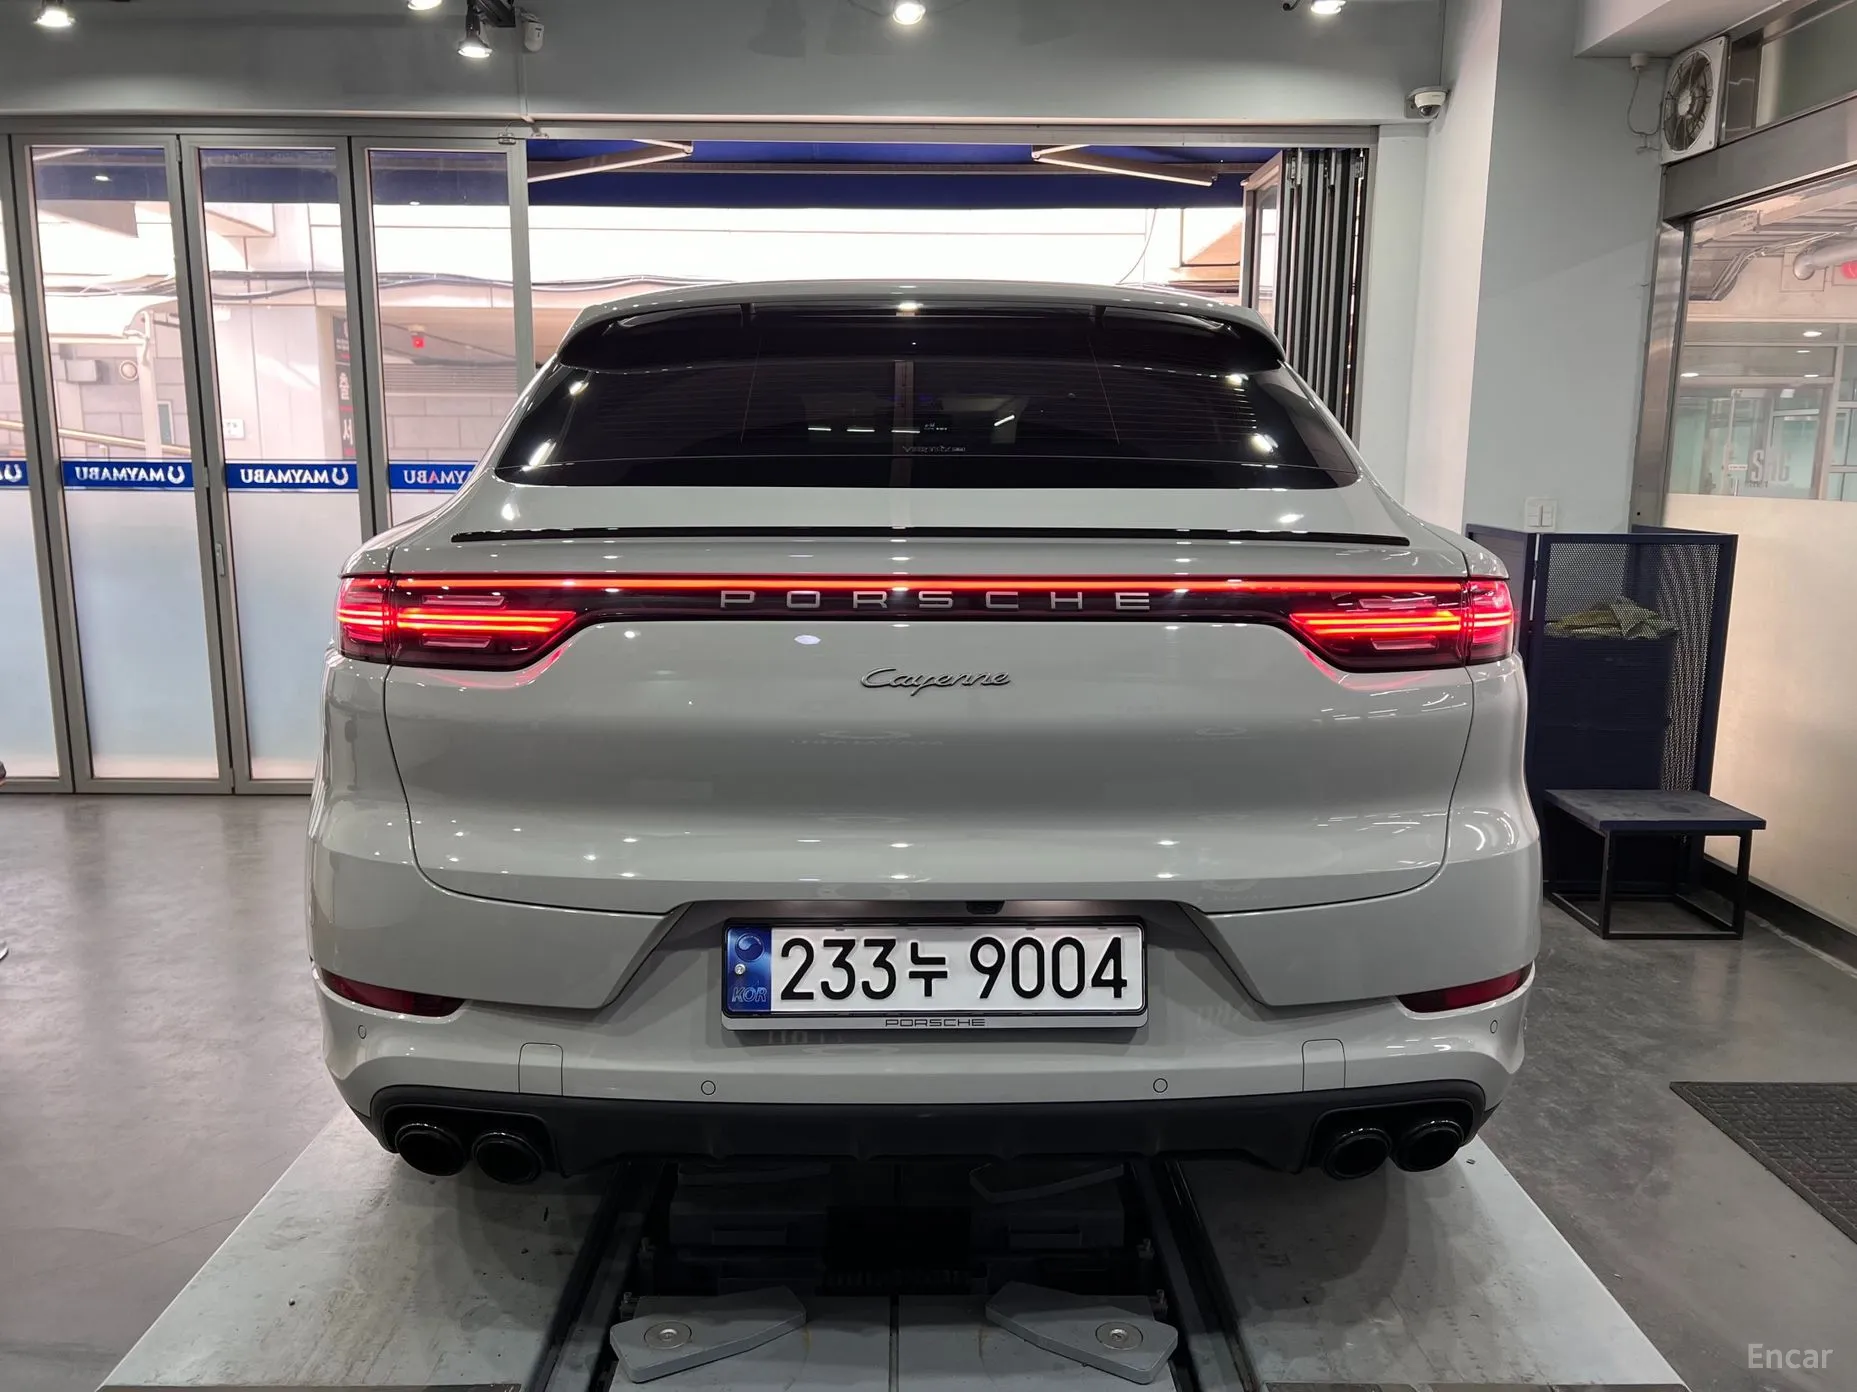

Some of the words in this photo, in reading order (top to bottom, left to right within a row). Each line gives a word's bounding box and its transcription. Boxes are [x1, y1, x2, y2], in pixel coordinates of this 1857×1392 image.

[720, 590, 1151, 610] PORSCHE
[860, 667, 1012, 696] Cayenne
[780, 937, 948, 1001] 233누
[969, 936, 1128, 1000] 9004
[731, 986, 768, 1003] KOR
[885, 1018, 986, 1027] PORSCHE
